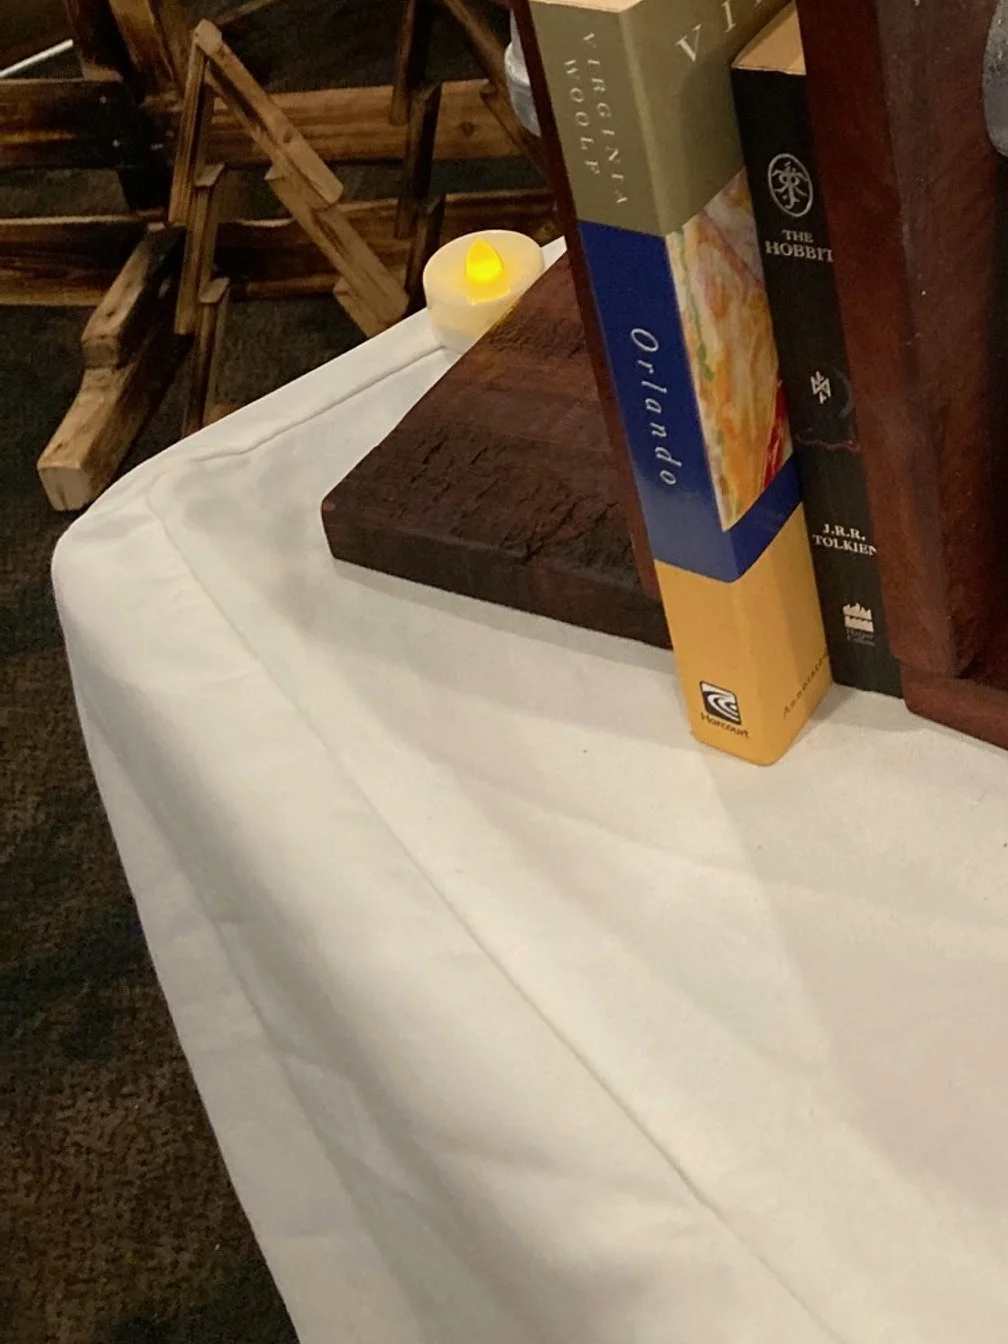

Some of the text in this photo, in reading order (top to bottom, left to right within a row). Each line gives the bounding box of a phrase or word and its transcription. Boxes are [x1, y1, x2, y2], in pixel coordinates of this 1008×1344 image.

[563, 58, 601, 176] WOOLF
[583, 32, 628, 205] VIRGINIA
[781, 229, 815, 244] THE
[764, 240, 834, 263] HOBBIT
[630, 327, 683, 486] Orlando
[822, 523, 866, 542] J.R.R.
[700, 711, 749, 739] Harcourt
